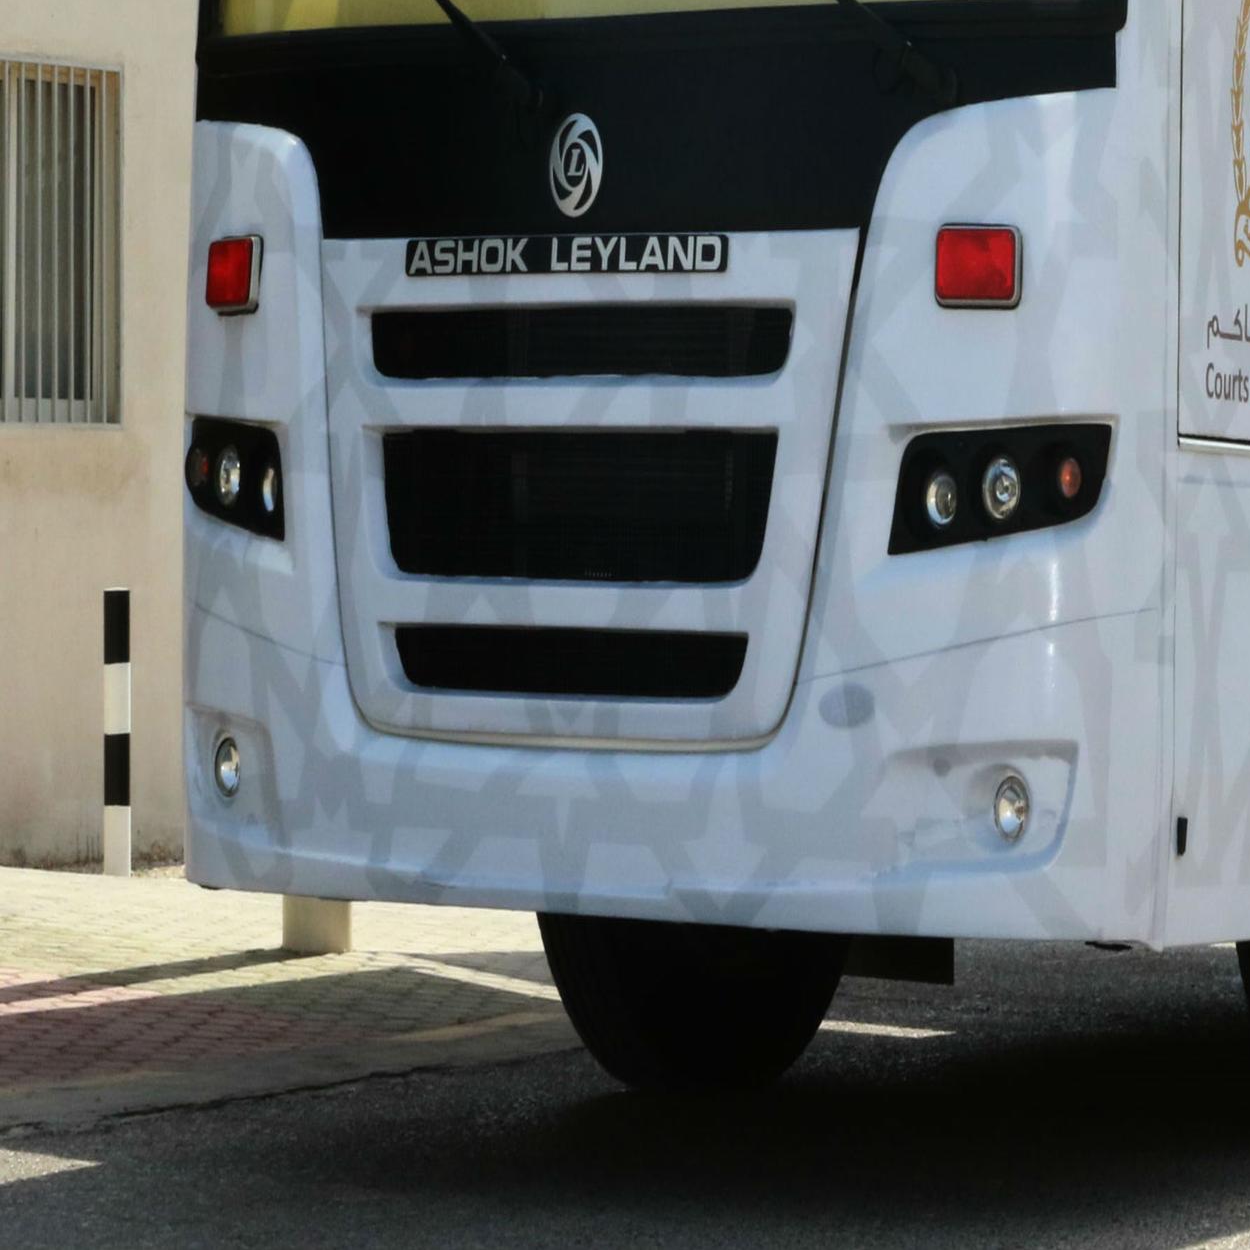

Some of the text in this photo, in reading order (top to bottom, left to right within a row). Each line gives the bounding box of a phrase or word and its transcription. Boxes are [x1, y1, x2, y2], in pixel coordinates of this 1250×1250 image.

[409, 235, 722, 274] ASHOK LEYLAND
[1205, 363, 1249, 404] Courts
